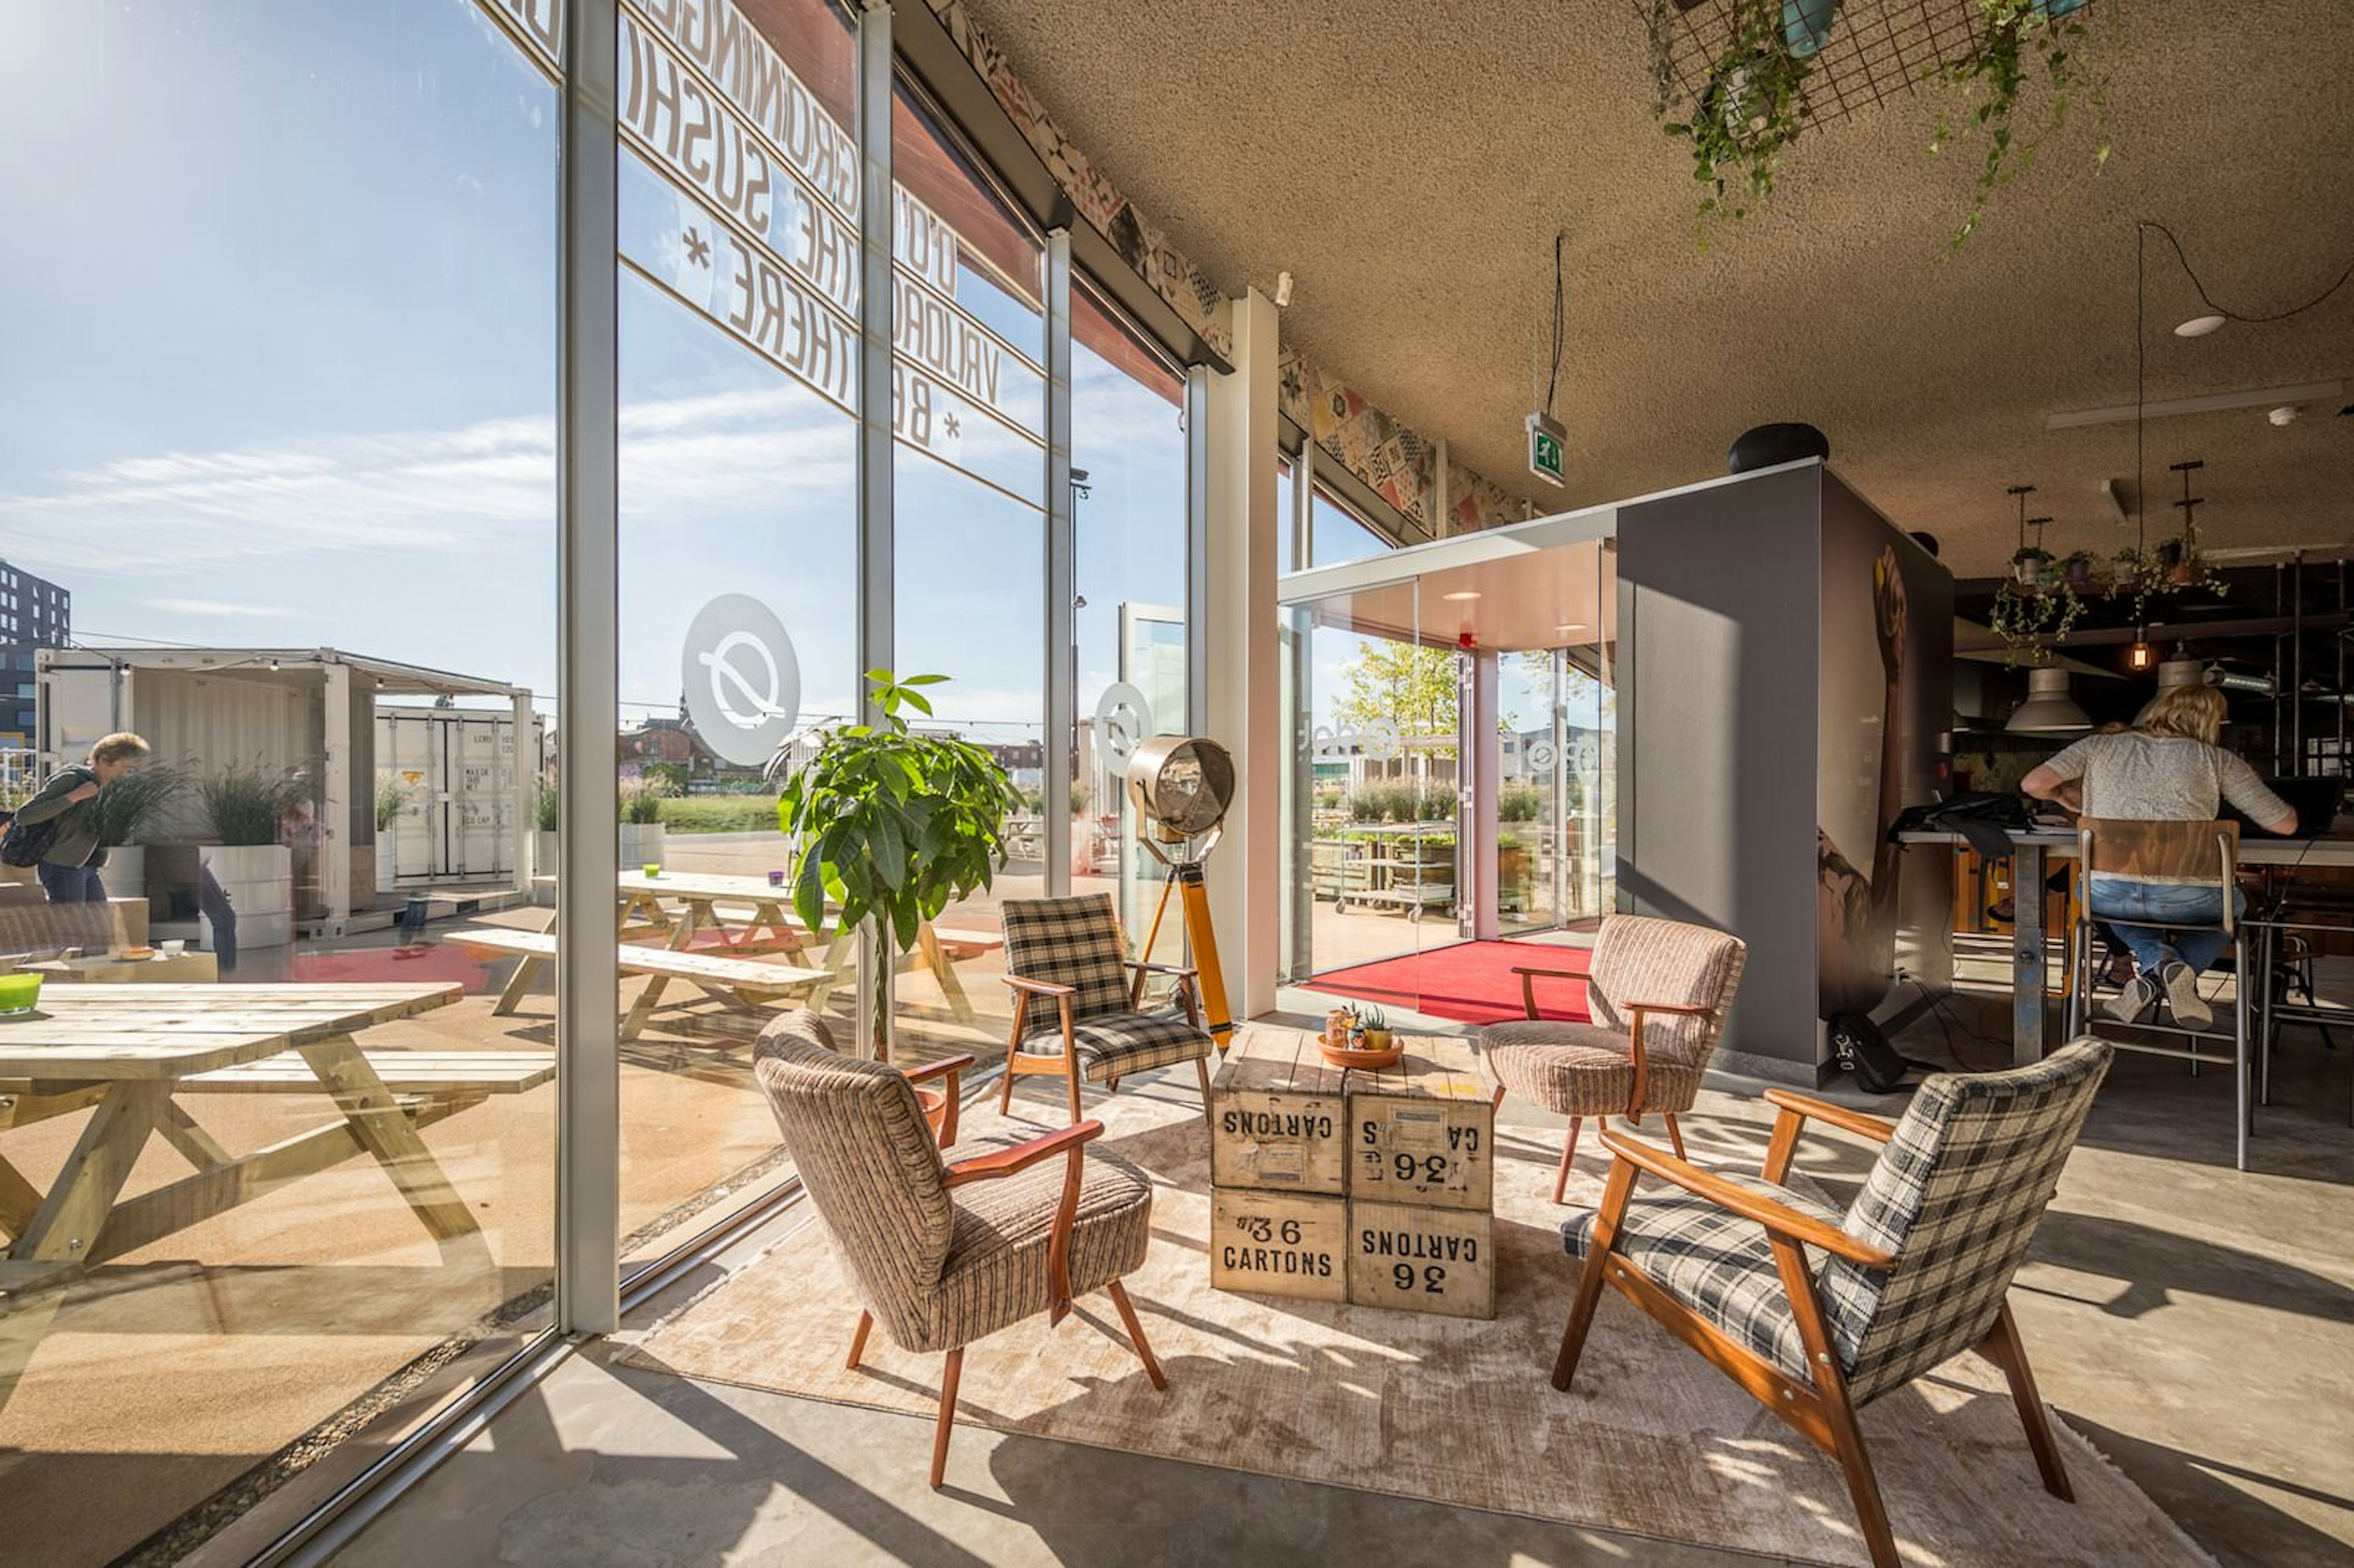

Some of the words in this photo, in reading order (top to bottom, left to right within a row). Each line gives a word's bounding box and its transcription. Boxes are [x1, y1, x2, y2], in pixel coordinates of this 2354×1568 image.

[1224, 1111, 1331, 1139] CARTONS
[1395, 1153, 1447, 1184] 36
[1252, 1217, 1301, 1245] 36
[1363, 1230, 1476, 1262] CARTONS
[1224, 1246, 1331, 1277] CARTONS
[1393, 1263, 1446, 1295] 36
